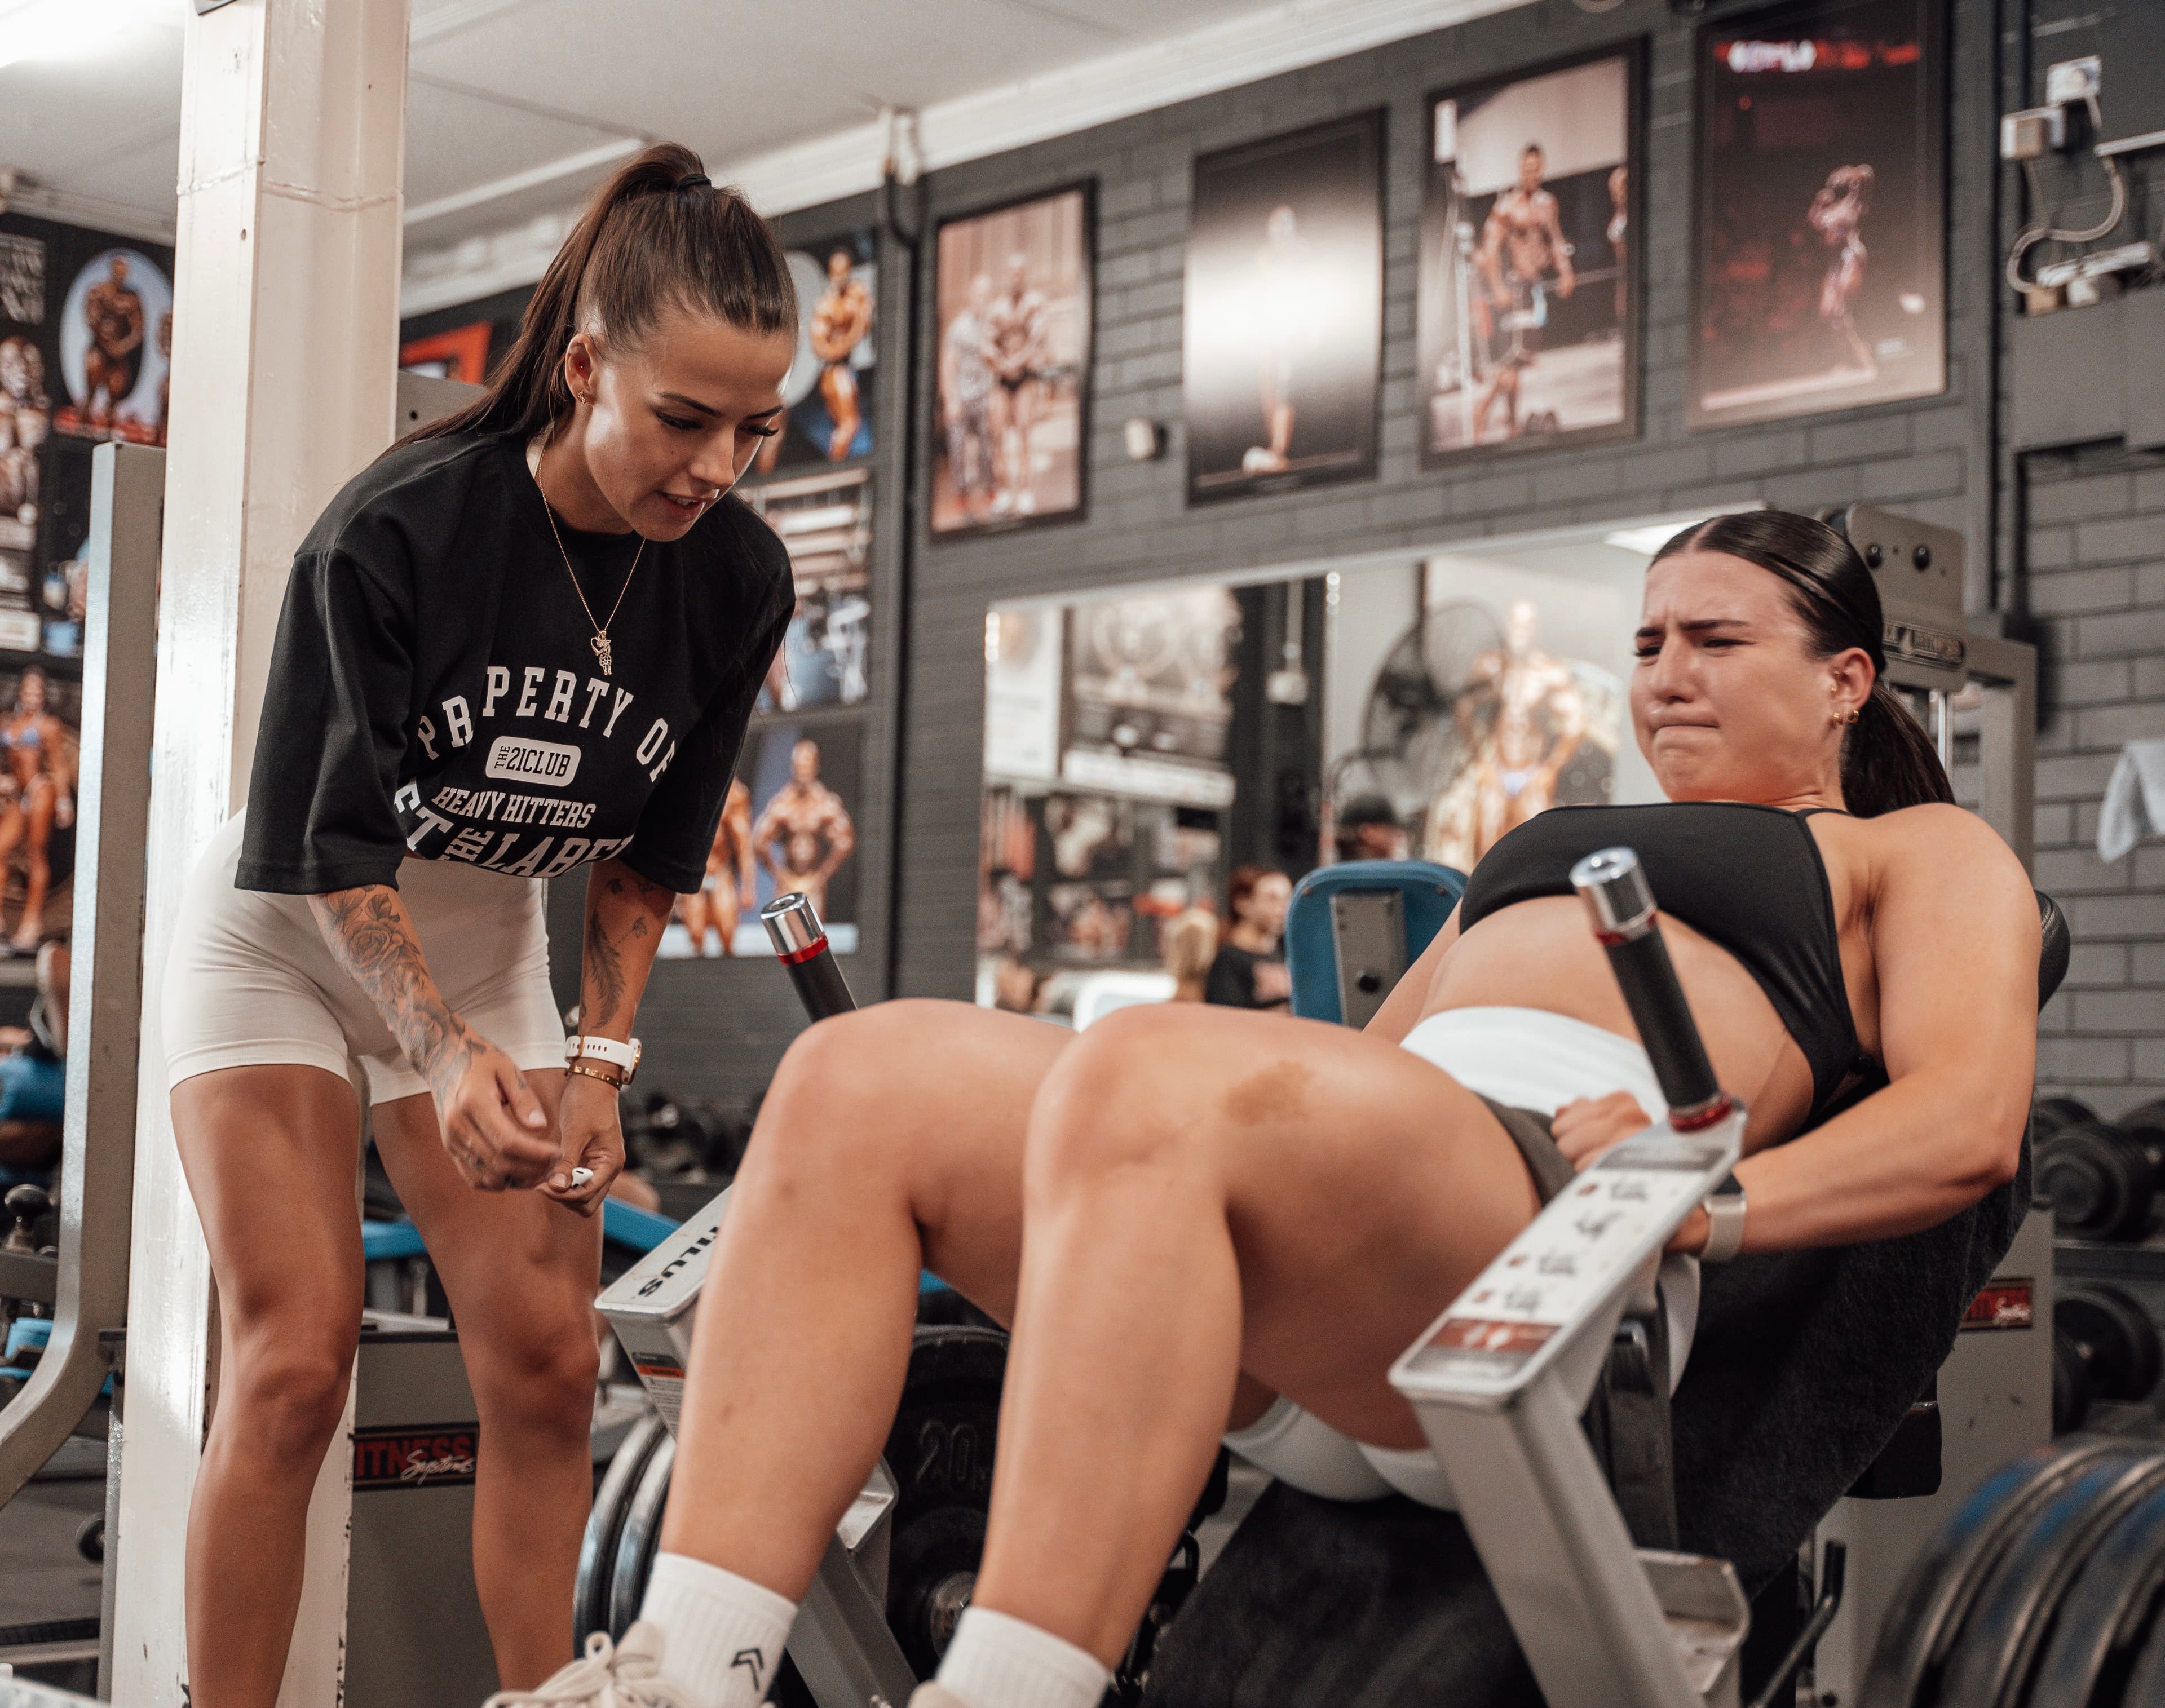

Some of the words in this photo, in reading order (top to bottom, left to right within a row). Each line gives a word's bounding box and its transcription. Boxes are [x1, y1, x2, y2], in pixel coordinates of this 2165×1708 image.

[418, 666, 634, 760] PRPERTY
[494, 745, 511, 769] THE
[431, 786, 506, 820] HEAVY
[501, 794, 597, 828] HITTERS
[438, 827, 496, 861] HE
[638, 1226, 719, 1297] ILUS
[355, 1435, 472, 1477] ITNESS
